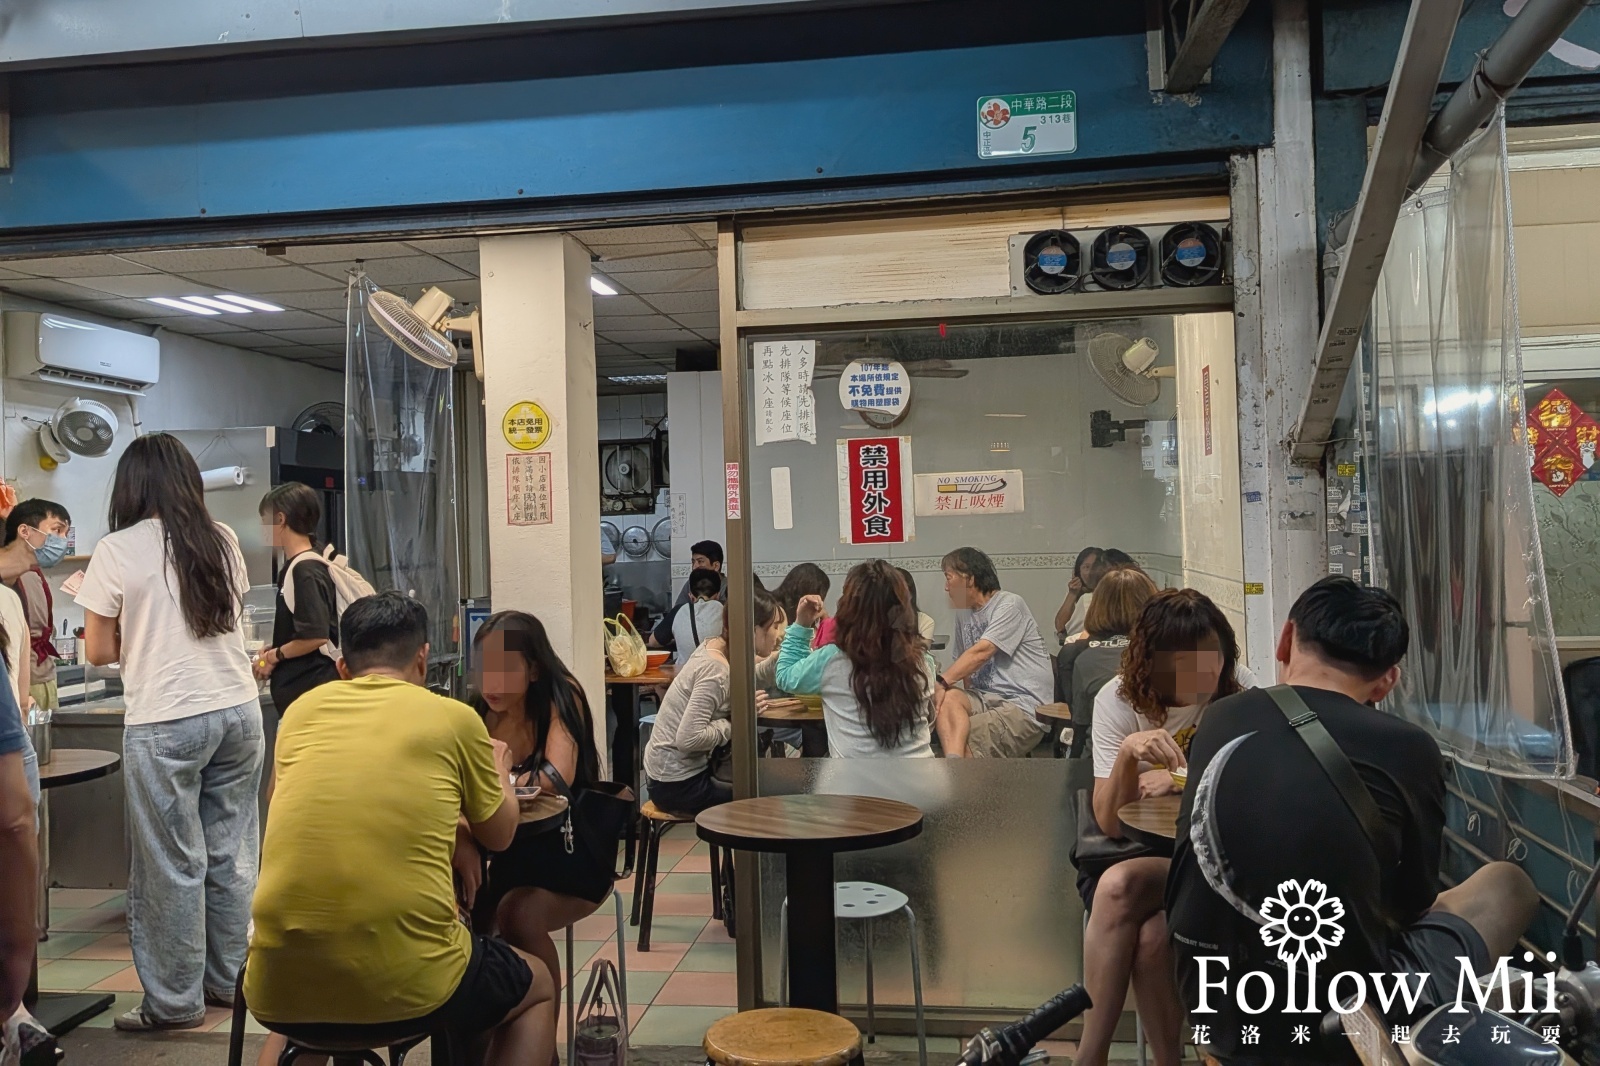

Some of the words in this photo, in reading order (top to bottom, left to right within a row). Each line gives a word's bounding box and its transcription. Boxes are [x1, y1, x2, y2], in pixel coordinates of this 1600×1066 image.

[1011, 94, 1073, 112] 中華路二段
[1040, 113, 1072, 125] 313巷
[1021, 126, 1037, 153] 5
[850, 373, 899, 383] 本場所依規定
[779, 344, 792, 434] 先排隊等候座位
[508, 417, 543, 426] 本店免用
[508, 426, 543, 434] 統一發票
[937, 476, 950, 484] NO
[954, 475, 997, 483] SMOKING
[860, 445, 891, 537] 禁用外食
[934, 493, 1005, 511] 禁止吸煙
